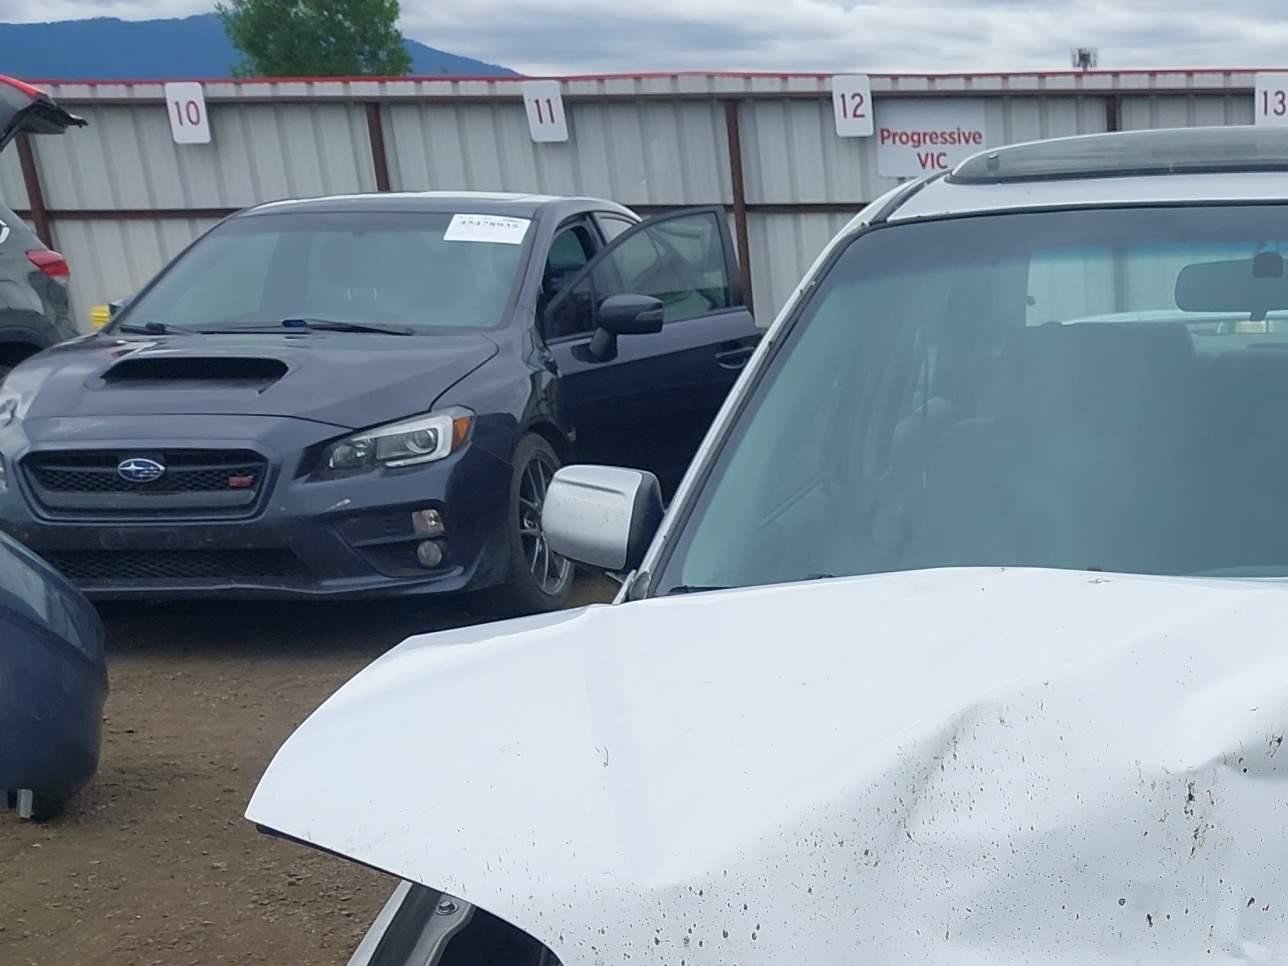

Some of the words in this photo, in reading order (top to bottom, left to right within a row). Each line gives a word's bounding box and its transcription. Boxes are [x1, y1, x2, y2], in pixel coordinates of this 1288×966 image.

[174, 100, 200, 126] 10
[534, 98, 556, 124] 11
[840, 92, 865, 119] 12
[1263, 90, 1286, 116] 13
[880, 126, 983, 148] Progressive
[916, 152, 948, 170] VIC
